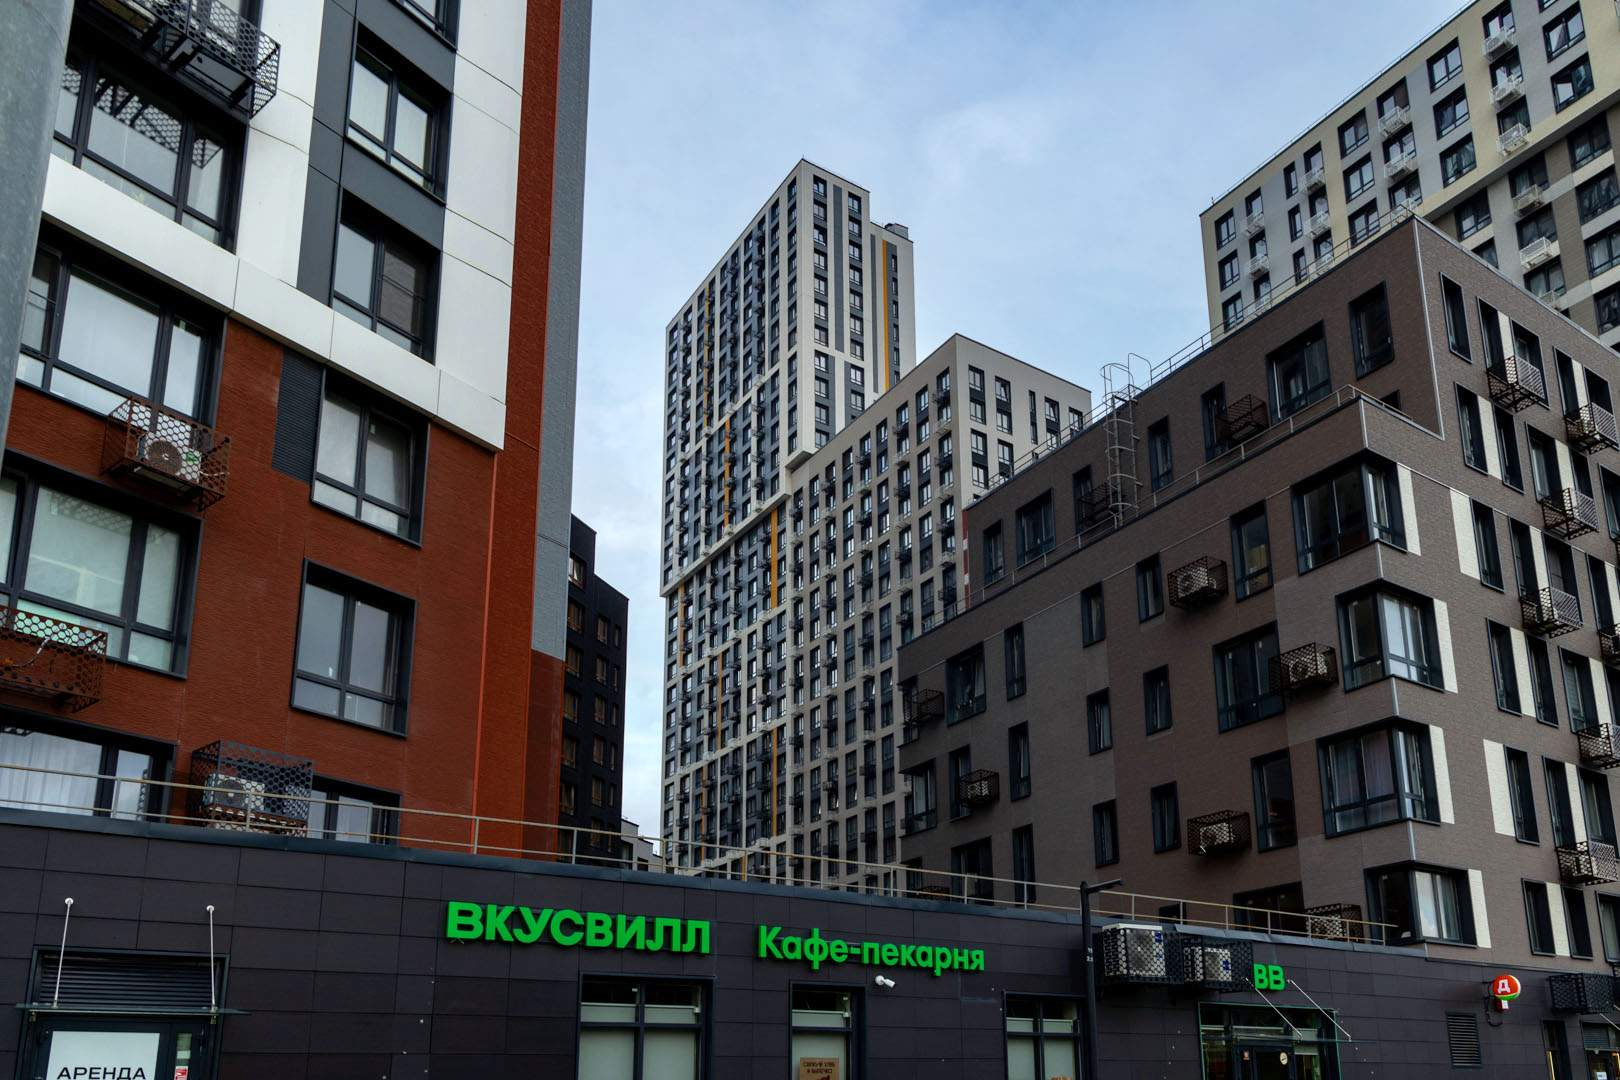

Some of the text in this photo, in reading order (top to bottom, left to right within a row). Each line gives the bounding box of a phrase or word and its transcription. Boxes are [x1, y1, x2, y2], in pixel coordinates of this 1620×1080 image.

[447, 901, 710, 954] ВКУСВИЛЛ
[758, 925, 985, 977] Кафе-пекарня
[1253, 963, 1286, 990] ВВ
[1497, 979, 1511, 993] Д
[57, 1067, 146, 1080] АРЕНДА
